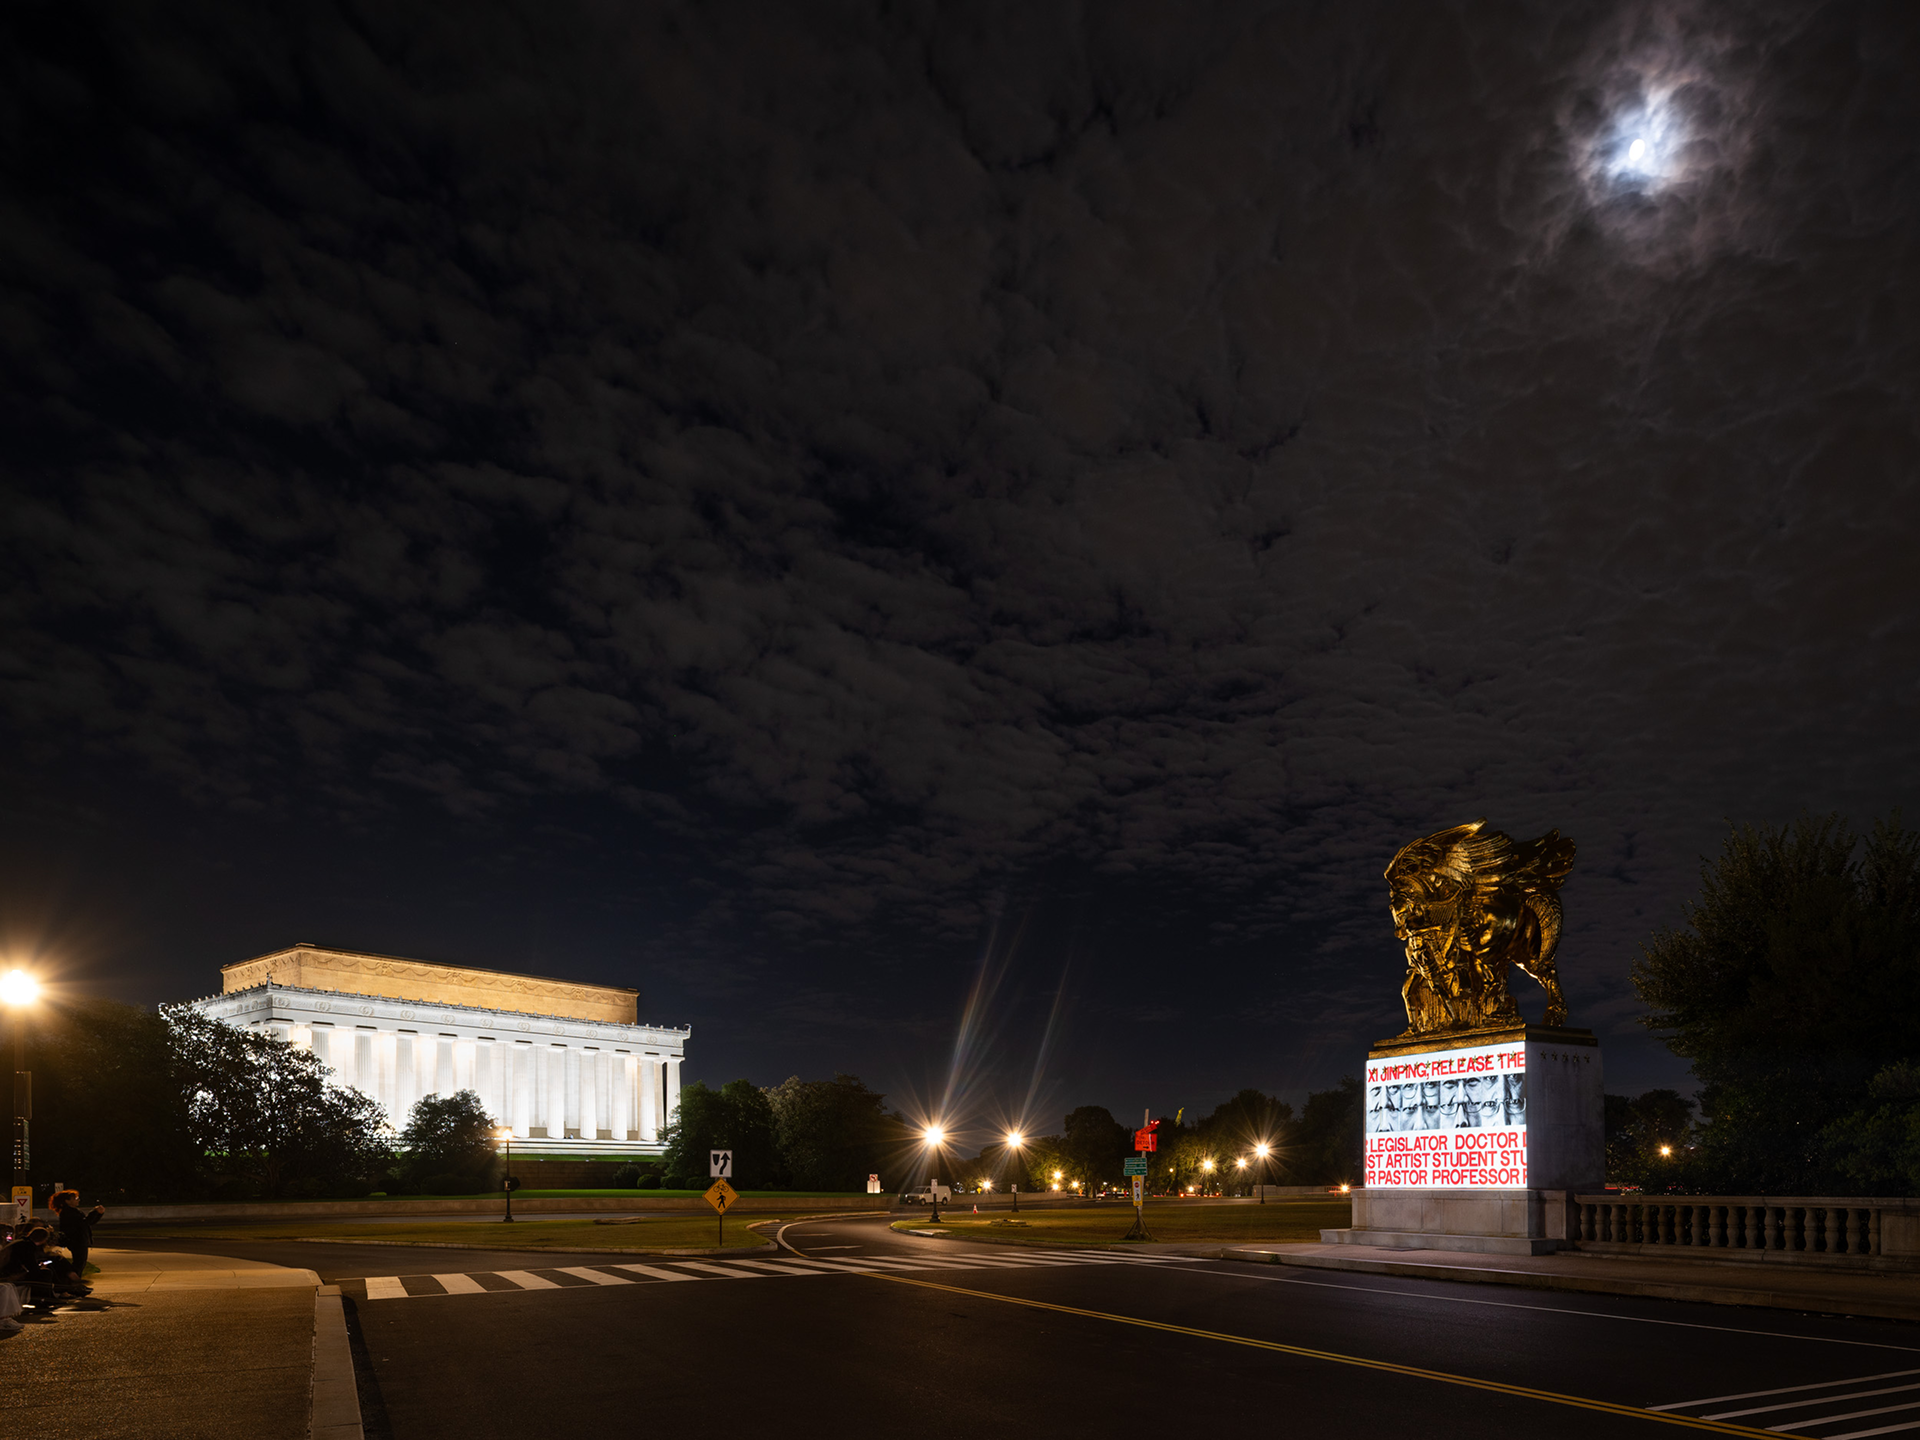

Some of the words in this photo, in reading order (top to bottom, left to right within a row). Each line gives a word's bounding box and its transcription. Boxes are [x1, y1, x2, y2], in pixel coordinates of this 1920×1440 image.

[1368, 1068, 1379, 1083] XI
[1380, 1062, 1430, 1082] JINPING,
[1431, 1054, 1494, 1077] RELEASE
[1497, 1051, 1526, 1069] THE
[1370, 1135, 1448, 1153] LEGISLATOR
[1455, 1132, 1519, 1150] DOCTOR
[1385, 1152, 1431, 1168] ARTIST
[1432, 1150, 1498, 1168] STUDENT
[1365, 1170, 1376, 1185] R
[1378, 1169, 1428, 1185] PASTOR
[1432, 1168, 1520, 1185] PROFESSOR
